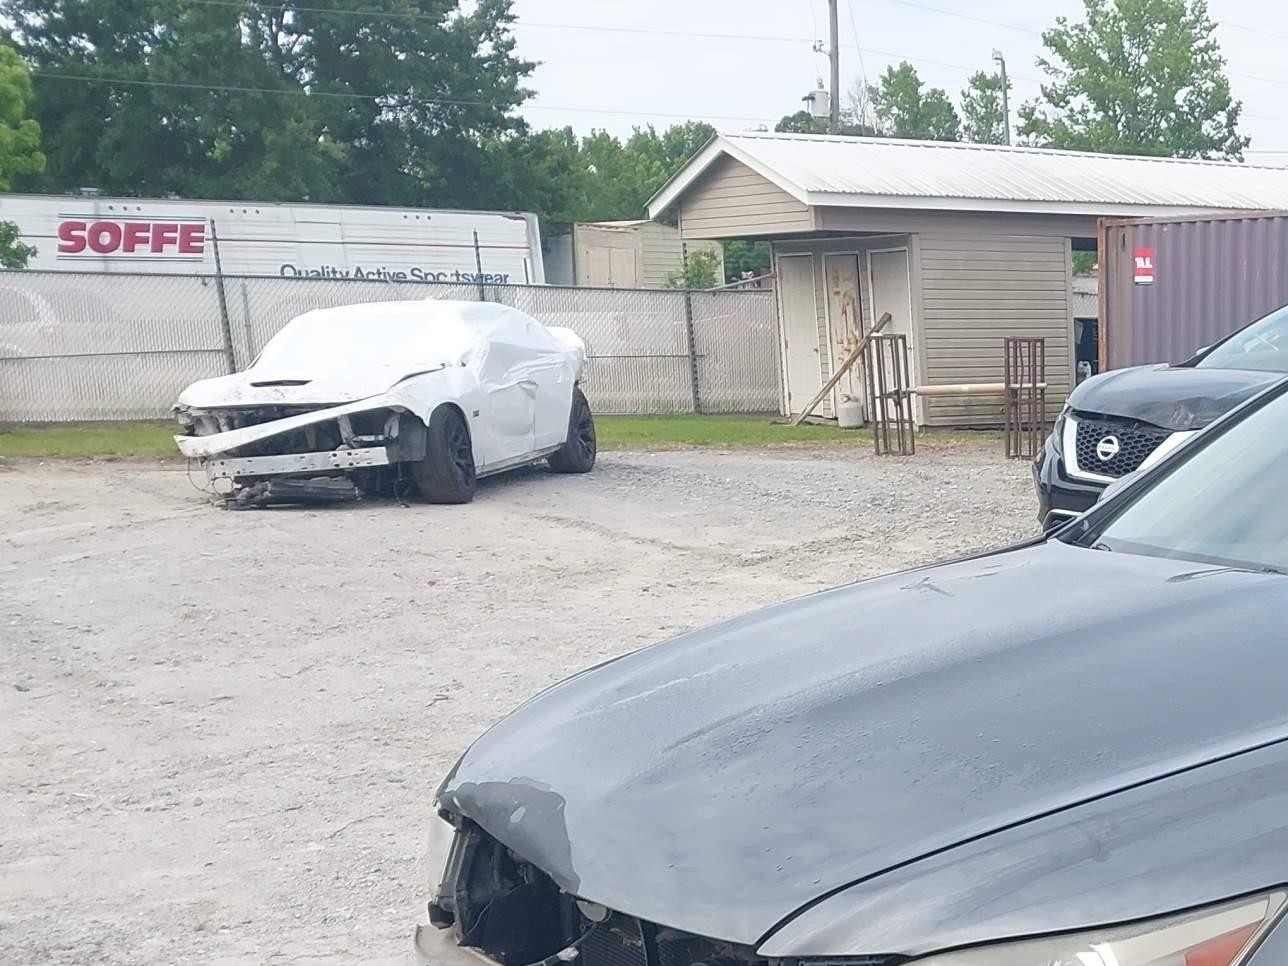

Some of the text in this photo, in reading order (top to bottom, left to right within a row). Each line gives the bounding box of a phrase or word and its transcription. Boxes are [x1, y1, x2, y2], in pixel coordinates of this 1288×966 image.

[57, 221, 205, 254] SOFFE
[353, 265, 407, 280] Active
[410, 267, 509, 284] Spotswear
